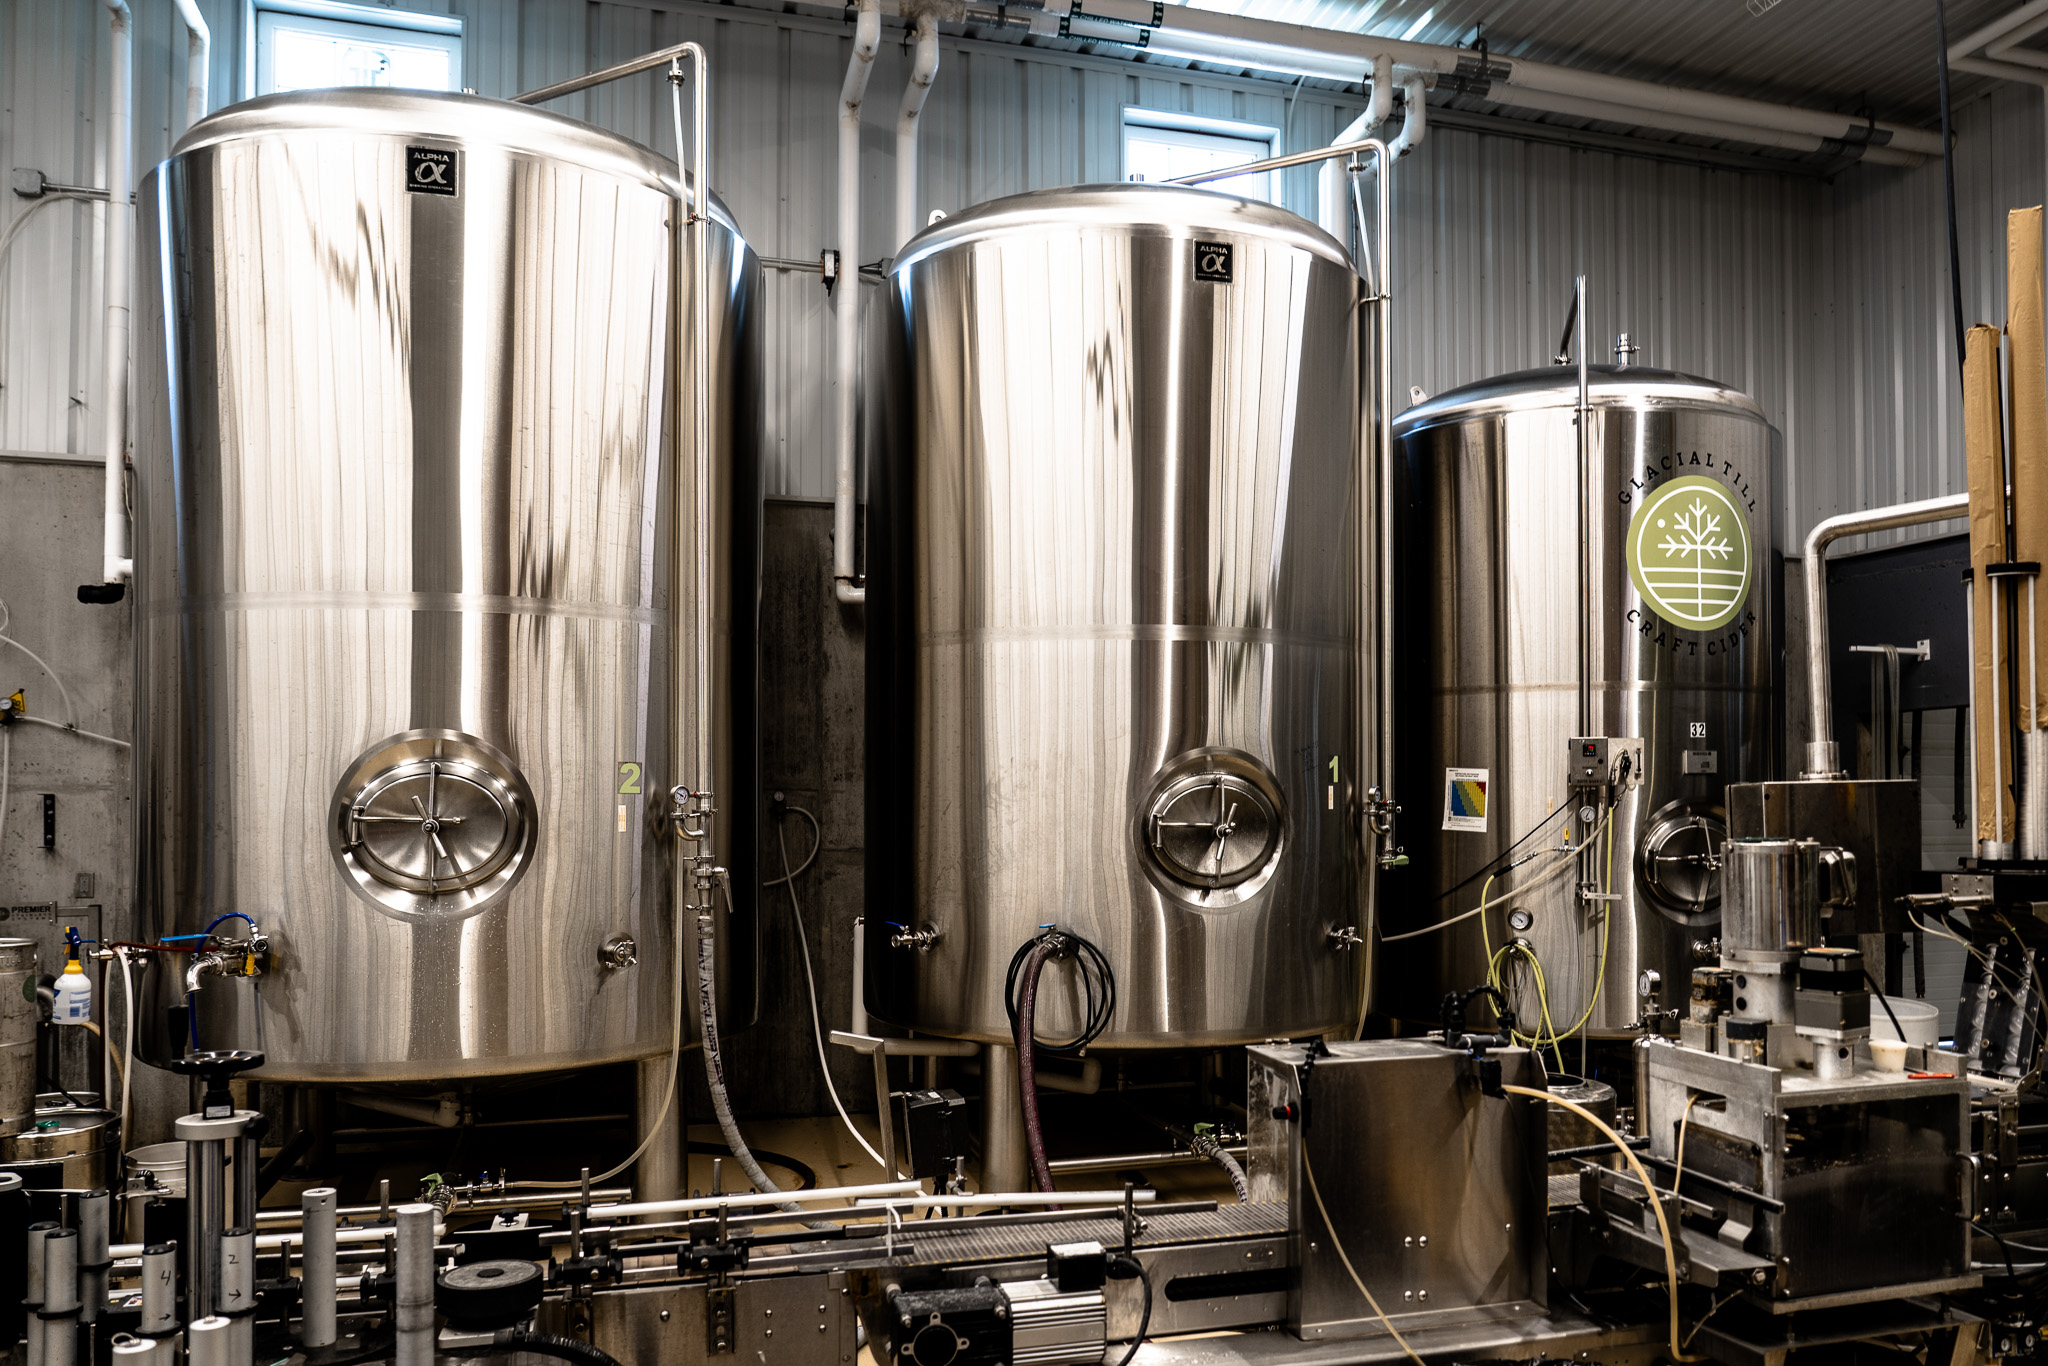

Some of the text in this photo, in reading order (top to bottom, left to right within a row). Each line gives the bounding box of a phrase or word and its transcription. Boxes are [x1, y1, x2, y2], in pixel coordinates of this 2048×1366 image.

[1080, 14, 1108, 24] CHILLED
[1068, 36, 1097, 44] CHILLED
[1098, 39, 1121, 48] WATER
[413, 152, 449, 162] ALPHA
[1200, 245, 1228, 254] ALPHA
[1618, 451, 1756, 512] GLACIAL TILL
[1626, 609, 1756, 656] CRAFT CIDER
[1691, 723, 1705, 737] 32
[1329, 755, 1339, 783] 1
[619, 762, 641, 794] 2
[11, 905, 51, 913] PREMIER
[160, 1270, 172, 1286] 4
